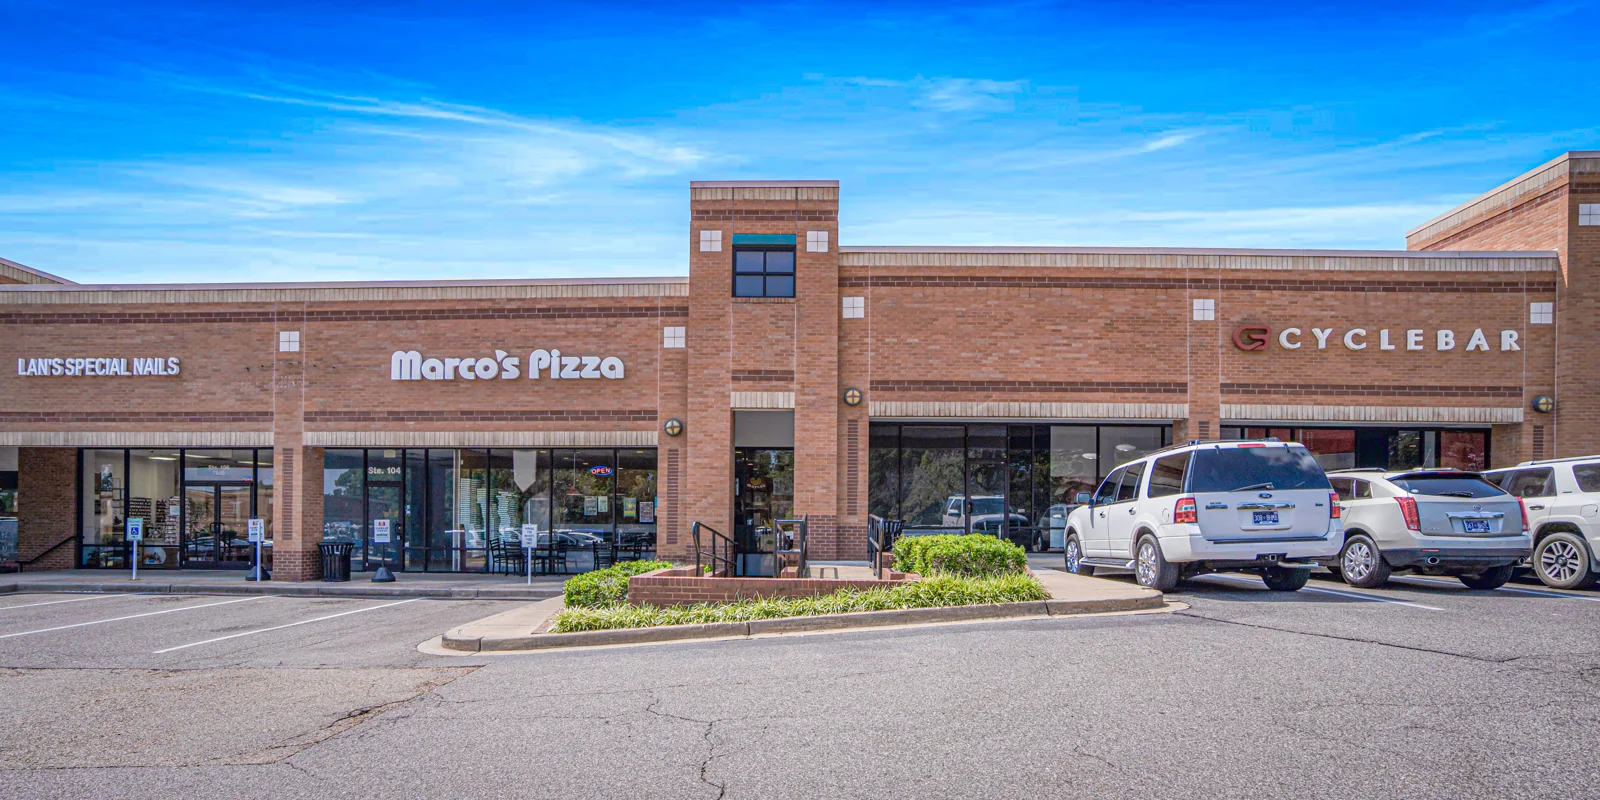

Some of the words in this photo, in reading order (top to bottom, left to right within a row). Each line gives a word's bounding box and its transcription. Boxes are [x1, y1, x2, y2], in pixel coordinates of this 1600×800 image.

[1279, 327, 1521, 351] CYCLEBAR
[18, 358, 65, 376] LAN'S
[65, 357, 132, 376] SPECIAL
[133, 356, 180, 376] NAILS
[390, 350, 521, 380] Marco's
[528, 348, 625, 380] Pizza
[368, 466, 384, 474] Ste.
[386, 466, 401, 474] 104
[591, 467, 611, 475] OPEN
